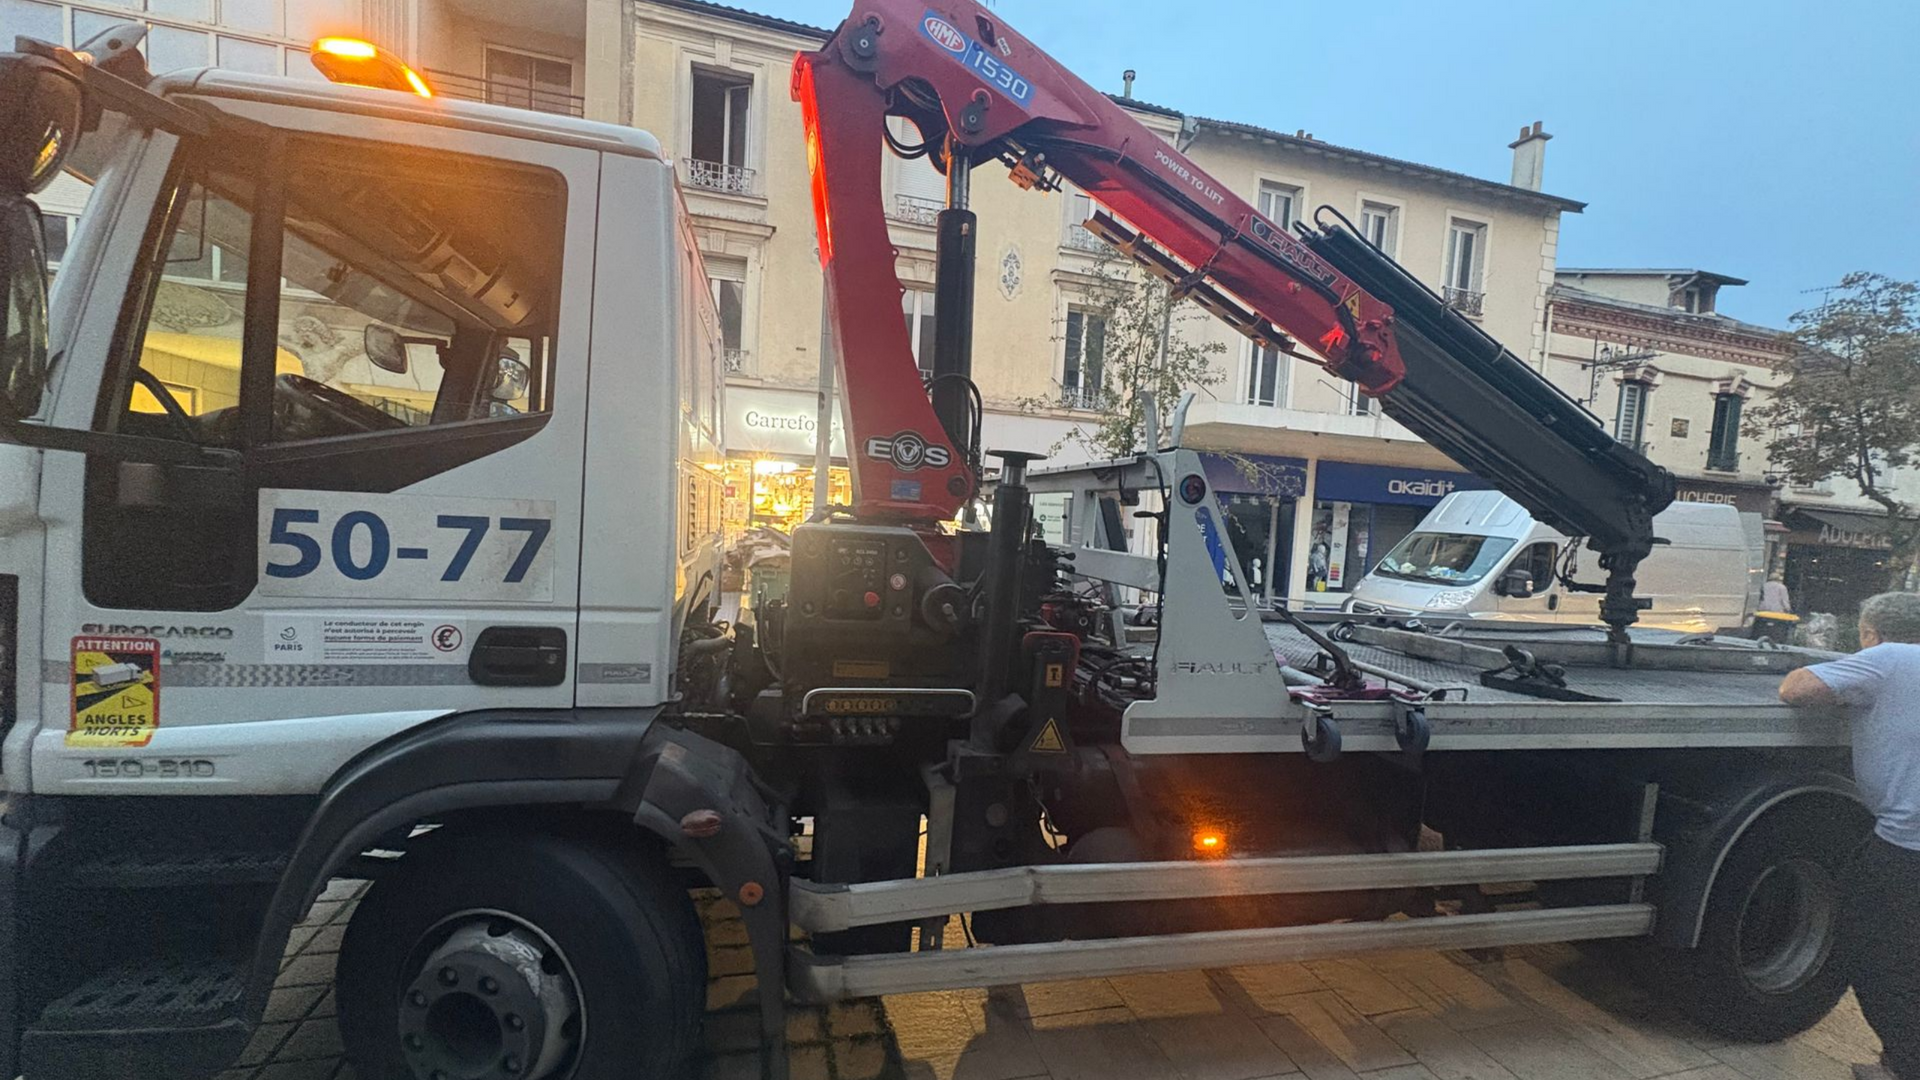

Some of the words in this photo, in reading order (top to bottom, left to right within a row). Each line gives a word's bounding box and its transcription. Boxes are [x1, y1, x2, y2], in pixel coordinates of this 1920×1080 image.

[929, 21, 961, 48] HMF
[974, 50, 1028, 99] 1530
[1154, 150, 1190, 180] POWER
[1191, 175, 1204, 190] TO
[1204, 186, 1225, 205] LIFT
[1267, 232, 1332, 281] FIAULT
[265, 508, 551, 583] 50-77
[82, 623, 233, 639] EUROCARGO
[76, 640, 155, 651] ATTENTION
[84, 714, 146, 725] ANGLES
[84, 726, 141, 736] MORTS
[84, 760, 215, 778] 150-310
